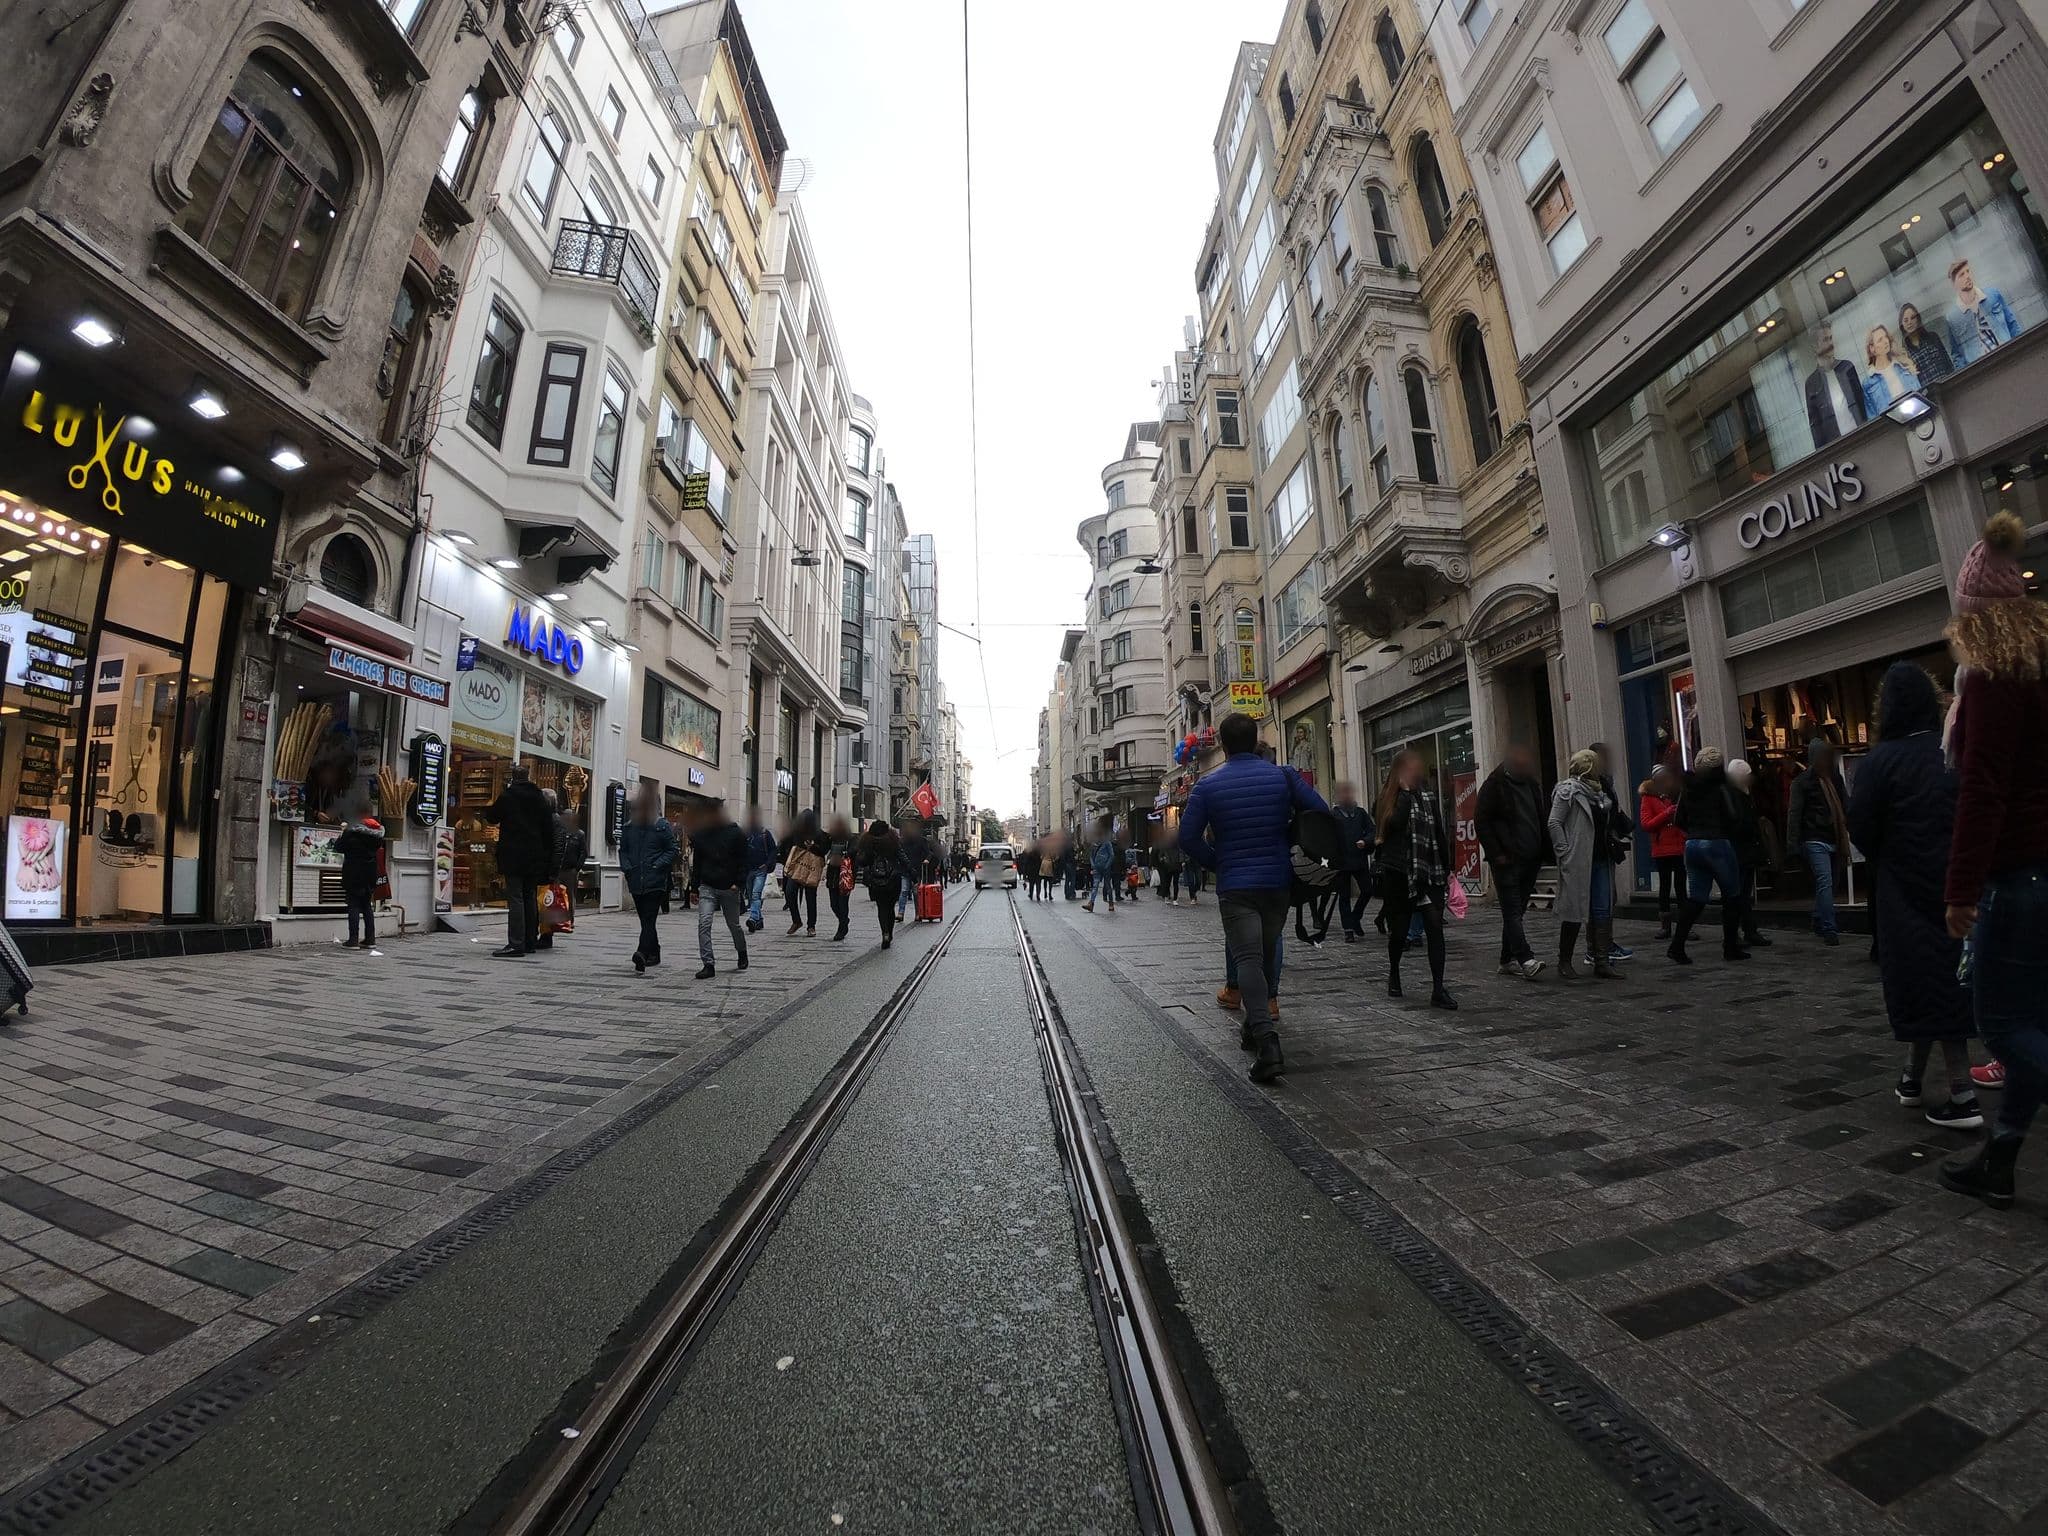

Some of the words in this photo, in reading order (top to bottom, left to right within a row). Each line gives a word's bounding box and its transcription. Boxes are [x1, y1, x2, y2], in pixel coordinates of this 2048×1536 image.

[1182, 372, 1193, 398] HDK
[184, 480, 211, 500] HAIR
[1737, 461, 1862, 549] COLIN'S
[504, 599, 584, 675] MADO
[1408, 640, 1453, 676] JeansLab
[35, 663, 49, 671] HAIR
[51, 667, 73, 678] DESIGN
[329, 648, 385, 687] K.MARAŞ
[388, 667, 407, 690] ICE
[409, 675, 445, 701] CREAM
[30, 686, 41, 694] SPA
[43, 689, 71, 701] PEDICURE
[468, 680, 501, 704] MADO
[1231, 684, 1261, 696] FAL
[425, 742, 442, 753] MADO
[1456, 820, 1477, 842] 50
